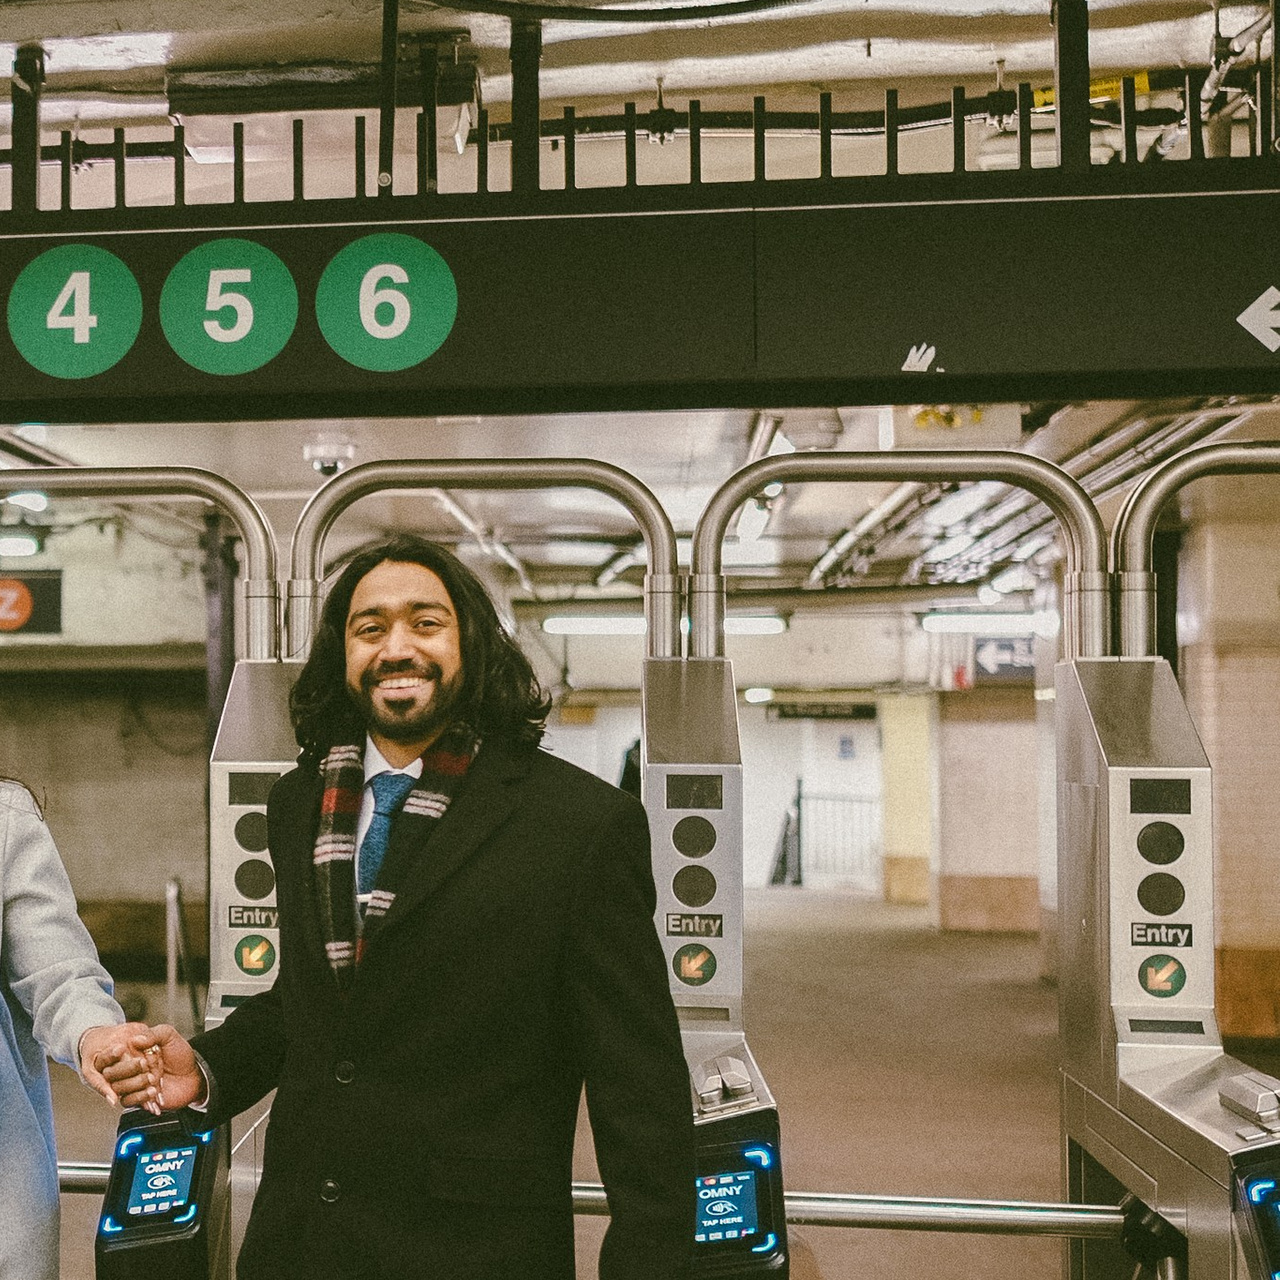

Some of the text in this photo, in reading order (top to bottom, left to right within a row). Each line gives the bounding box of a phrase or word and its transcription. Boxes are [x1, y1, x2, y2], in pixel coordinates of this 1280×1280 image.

[45, 271, 98, 345] 4
[201, 268, 255, 344] 5
[357, 263, 412, 340] 6
[230, 907, 278, 928] Entry
[667, 914, 721, 936] Entry
[1132, 923, 1190, 946] Entry
[144, 1159, 185, 1175] OMNY
[141, 1192, 156, 1200] TAP
[699, 1185, 743, 1199] OMNY
[701, 1216, 744, 1227] TAP HERE
